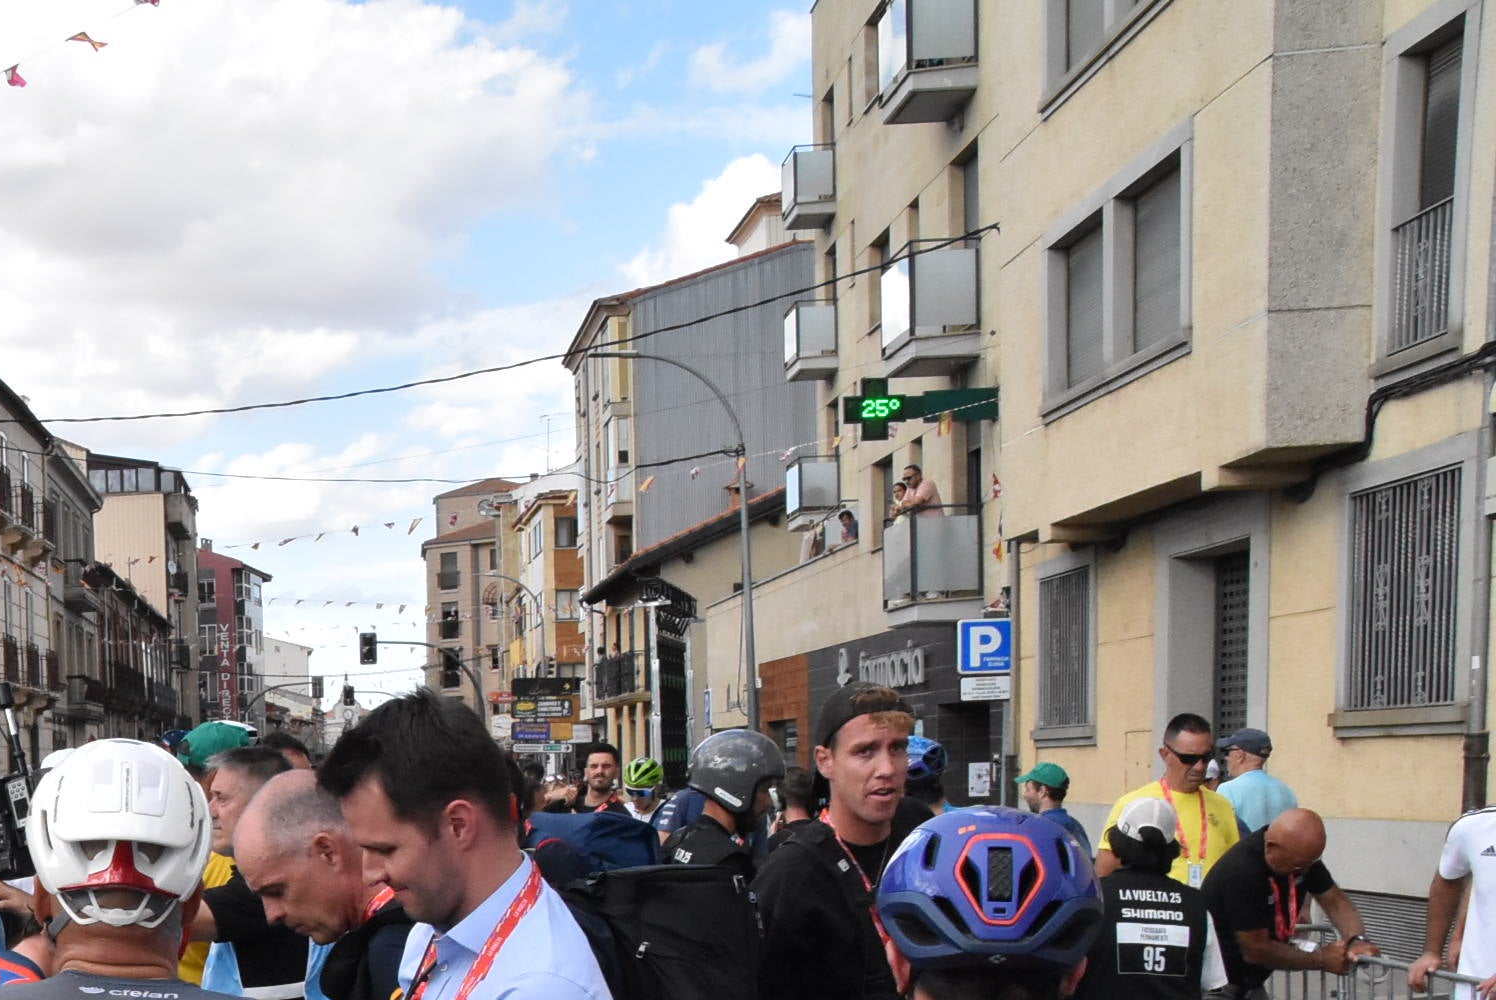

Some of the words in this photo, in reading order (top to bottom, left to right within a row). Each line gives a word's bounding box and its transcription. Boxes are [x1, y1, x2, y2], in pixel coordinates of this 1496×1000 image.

[219, 624, 231, 667] VENTA
[970, 626, 1002, 667] P
[859, 640, 925, 688] farmacia
[1119, 889, 1132, 900] LA
[1132, 890, 1169, 902] VUELTA
[1169, 893, 1182, 904] 25
[1121, 908, 1184, 921] SHIMANO
[1143, 946, 1166, 972] 95
[109, 988, 179, 999] crelan
